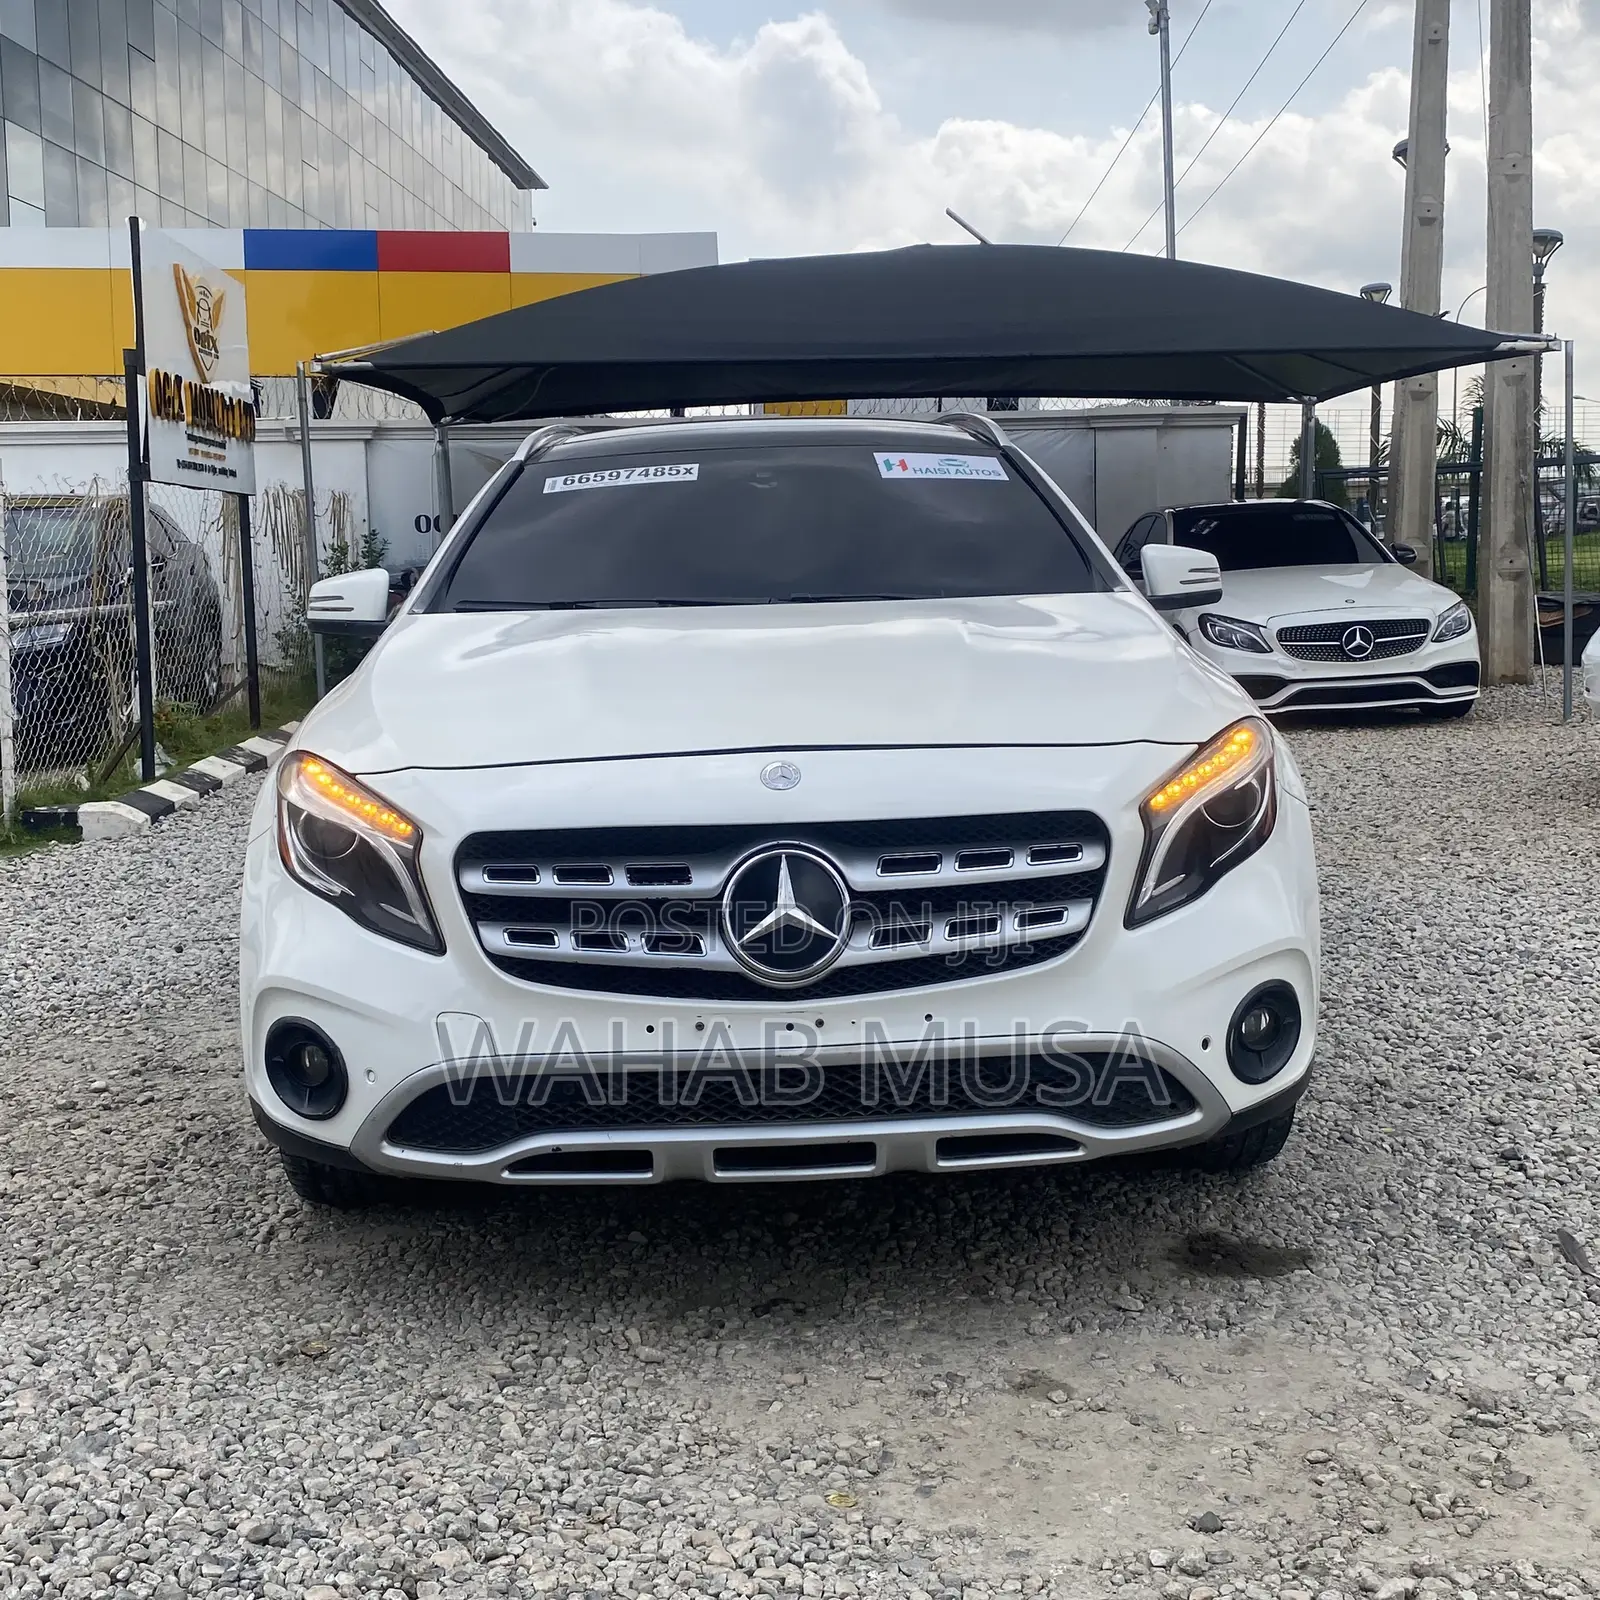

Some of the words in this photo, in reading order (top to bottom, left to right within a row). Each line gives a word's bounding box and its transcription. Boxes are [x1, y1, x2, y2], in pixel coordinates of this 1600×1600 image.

[562, 465, 695, 487] 66597485x
[912, 467, 952, 475] HAISI
[954, 468, 1002, 477] AUTOS
